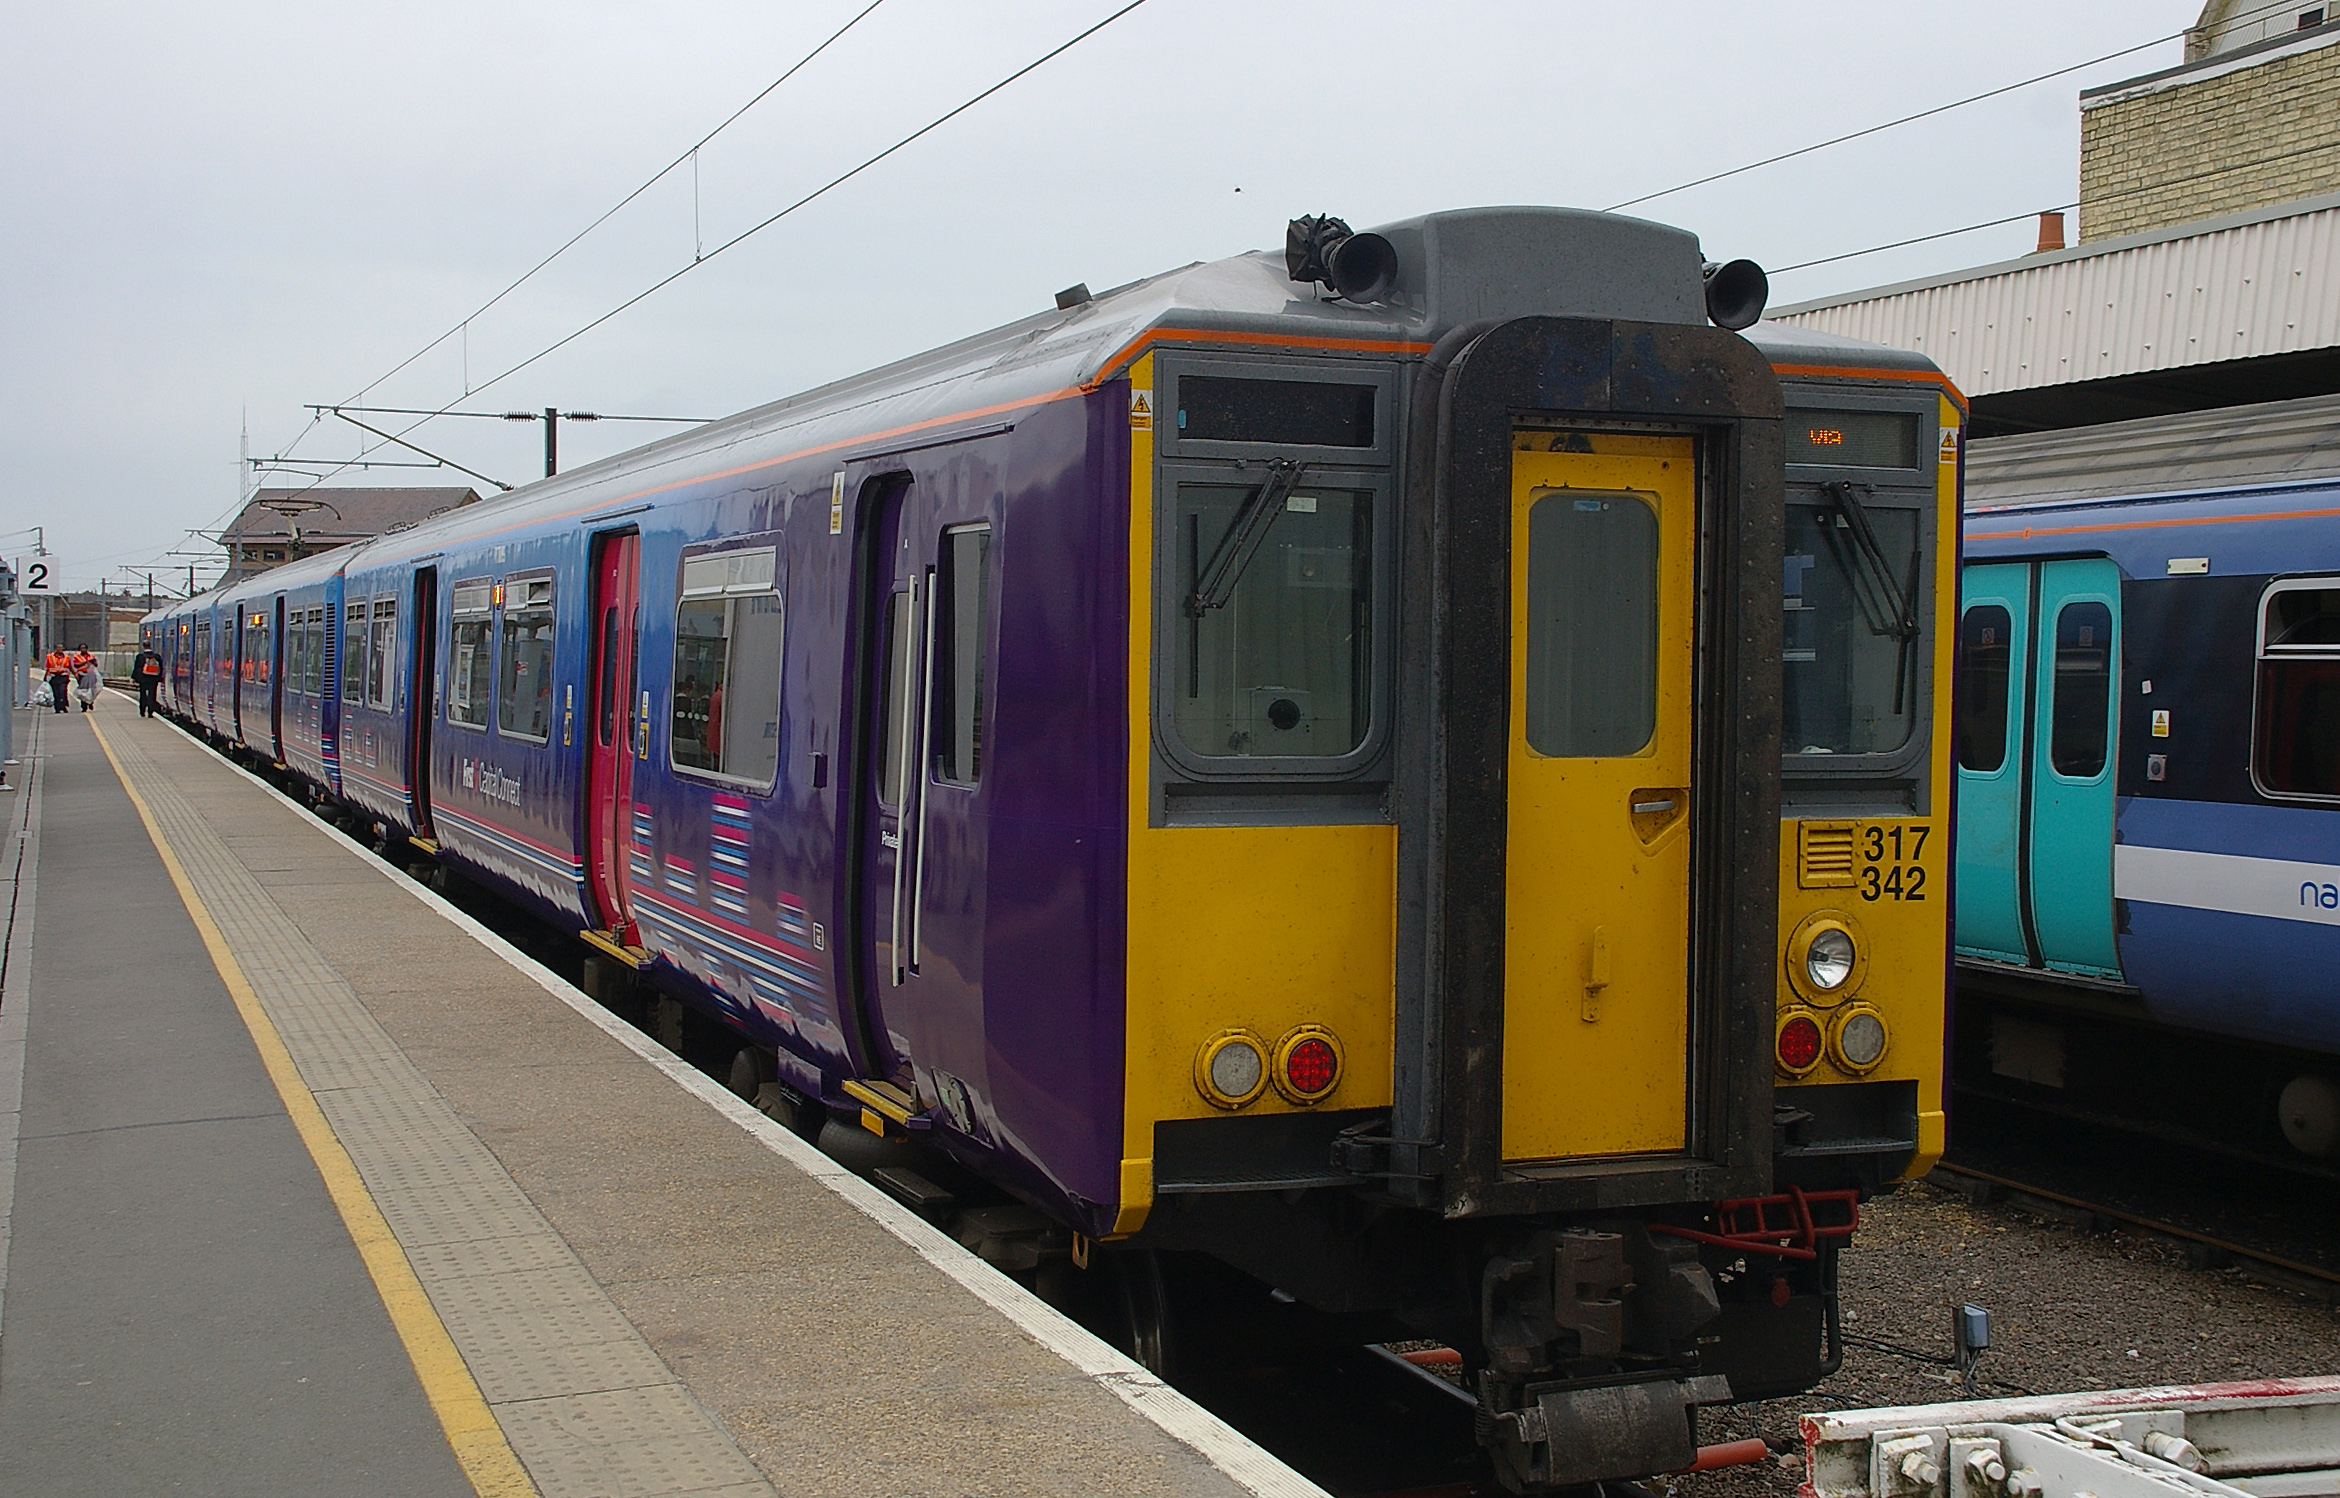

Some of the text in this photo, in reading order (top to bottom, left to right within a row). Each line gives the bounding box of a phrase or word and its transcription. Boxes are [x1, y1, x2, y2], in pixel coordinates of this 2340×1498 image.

[28, 563, 48, 589] 2
[1864, 825, 1931, 862] 317
[1861, 865, 1926, 902] 342
[2300, 881, 2339, 909] na
